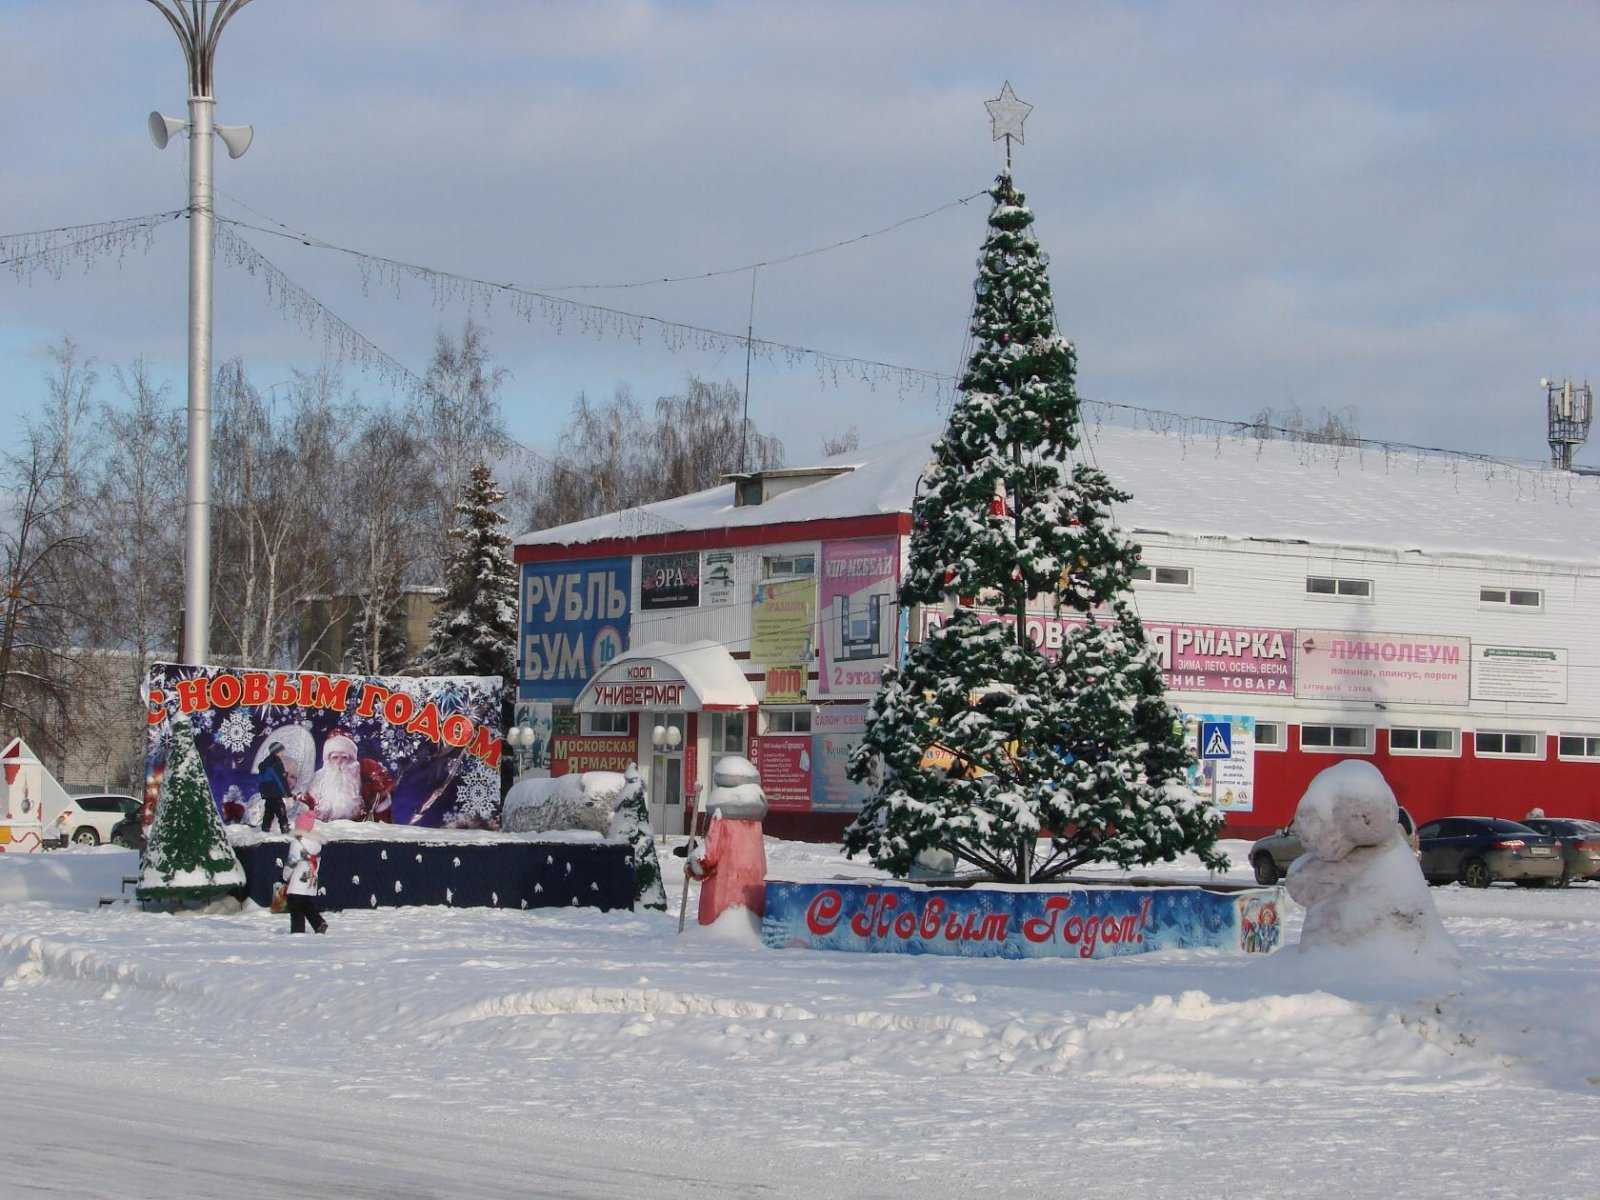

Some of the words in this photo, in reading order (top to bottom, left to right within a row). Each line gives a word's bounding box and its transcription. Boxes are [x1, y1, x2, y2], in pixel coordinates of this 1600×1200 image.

[655, 567, 684, 588] ЭРА
[526, 571, 626, 623] РУБЛЬ
[525, 632, 587, 680] БУМ
[1153, 627, 1287, 670] ЯРМАРКА
[1329, 639, 1460, 665] ЛИНОЛЕУМ
[834, 667, 844, 686] 2
[1178, 659, 1204, 672] ЗИМА,
[1205, 661, 1229, 673] ЛЕТО,
[1230, 662, 1260, 675] ОСЕНЬ,
[1261, 664, 1288, 675] ВЕСНА
[594, 685, 687, 705] УНИВЕРМАГ
[1222, 677, 1288, 690] ТОВАРА
[175, 672, 351, 715] НОВЫМ
[356, 683, 503, 769] ГОДОМ
[554, 740, 636, 760] МОСКОВСКАЯ
[806, 889, 844, 936] С
[851, 892, 1011, 942] Новым
[1023, 895, 1150, 959] Годом!
